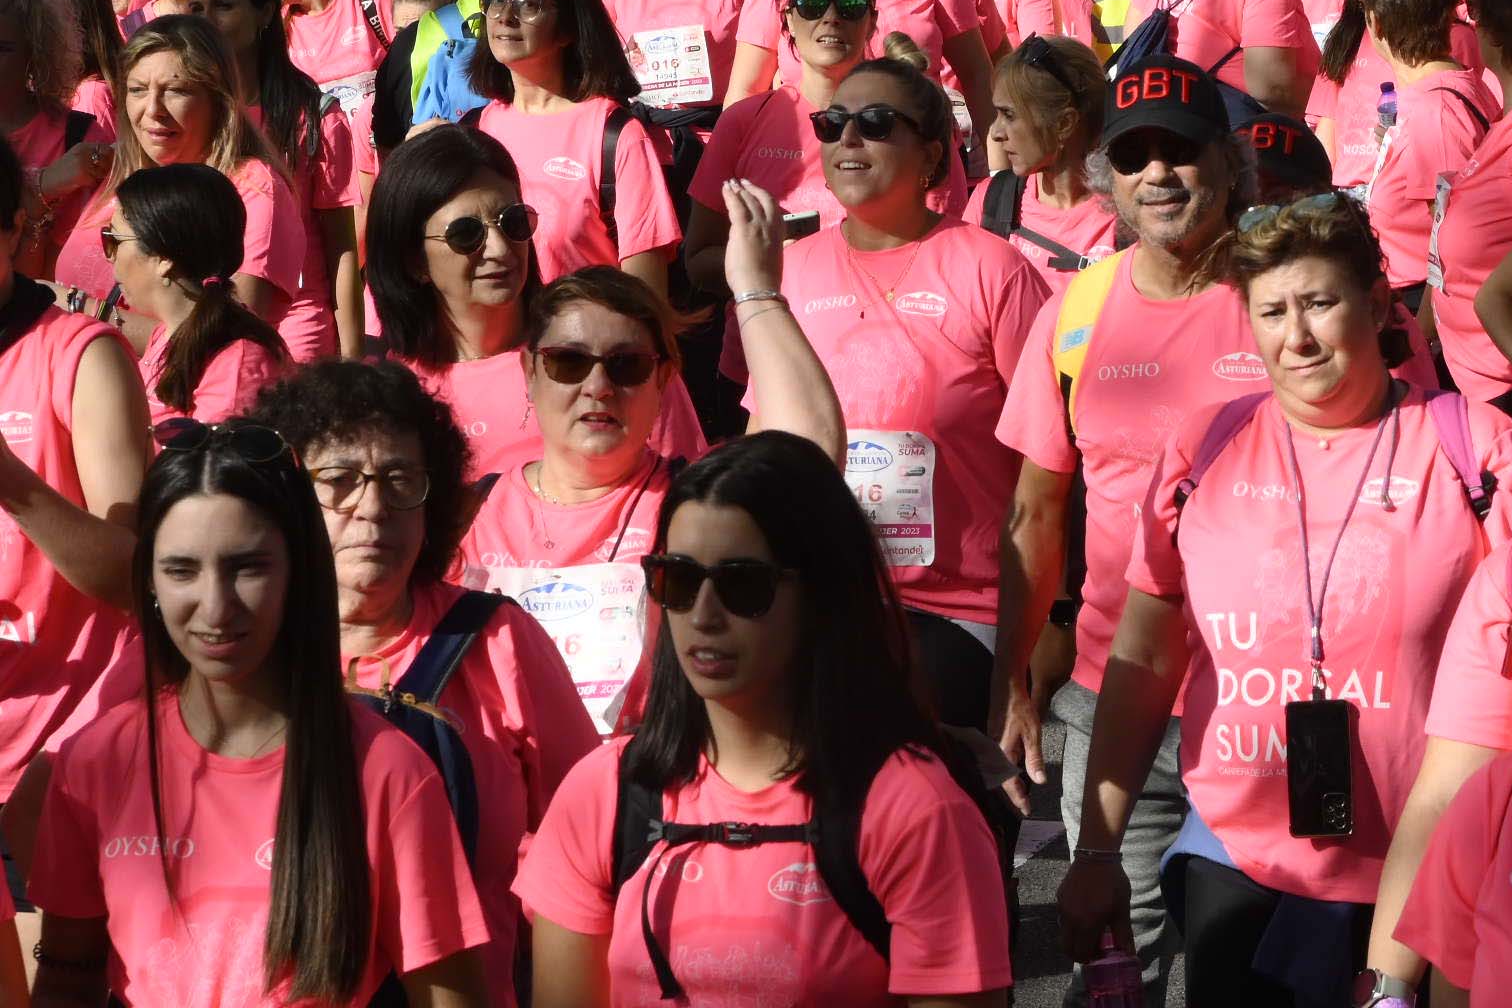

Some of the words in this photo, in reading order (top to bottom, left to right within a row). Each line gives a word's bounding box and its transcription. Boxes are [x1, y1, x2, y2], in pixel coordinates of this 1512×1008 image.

[651, 58, 680, 71] 016
[1115, 66, 1199, 110] GBT
[1237, 121, 1300, 155] BT
[758, 146, 806, 159] OYSHO
[804, 294, 857, 315] OYSHO
[1098, 362, 1160, 381] OYSHO
[848, 456, 888, 465] TURIANA
[521, 596, 589, 612] ASTURIANA
[1206, 611, 1257, 651] TU
[1215, 723, 1287, 763] SUM
